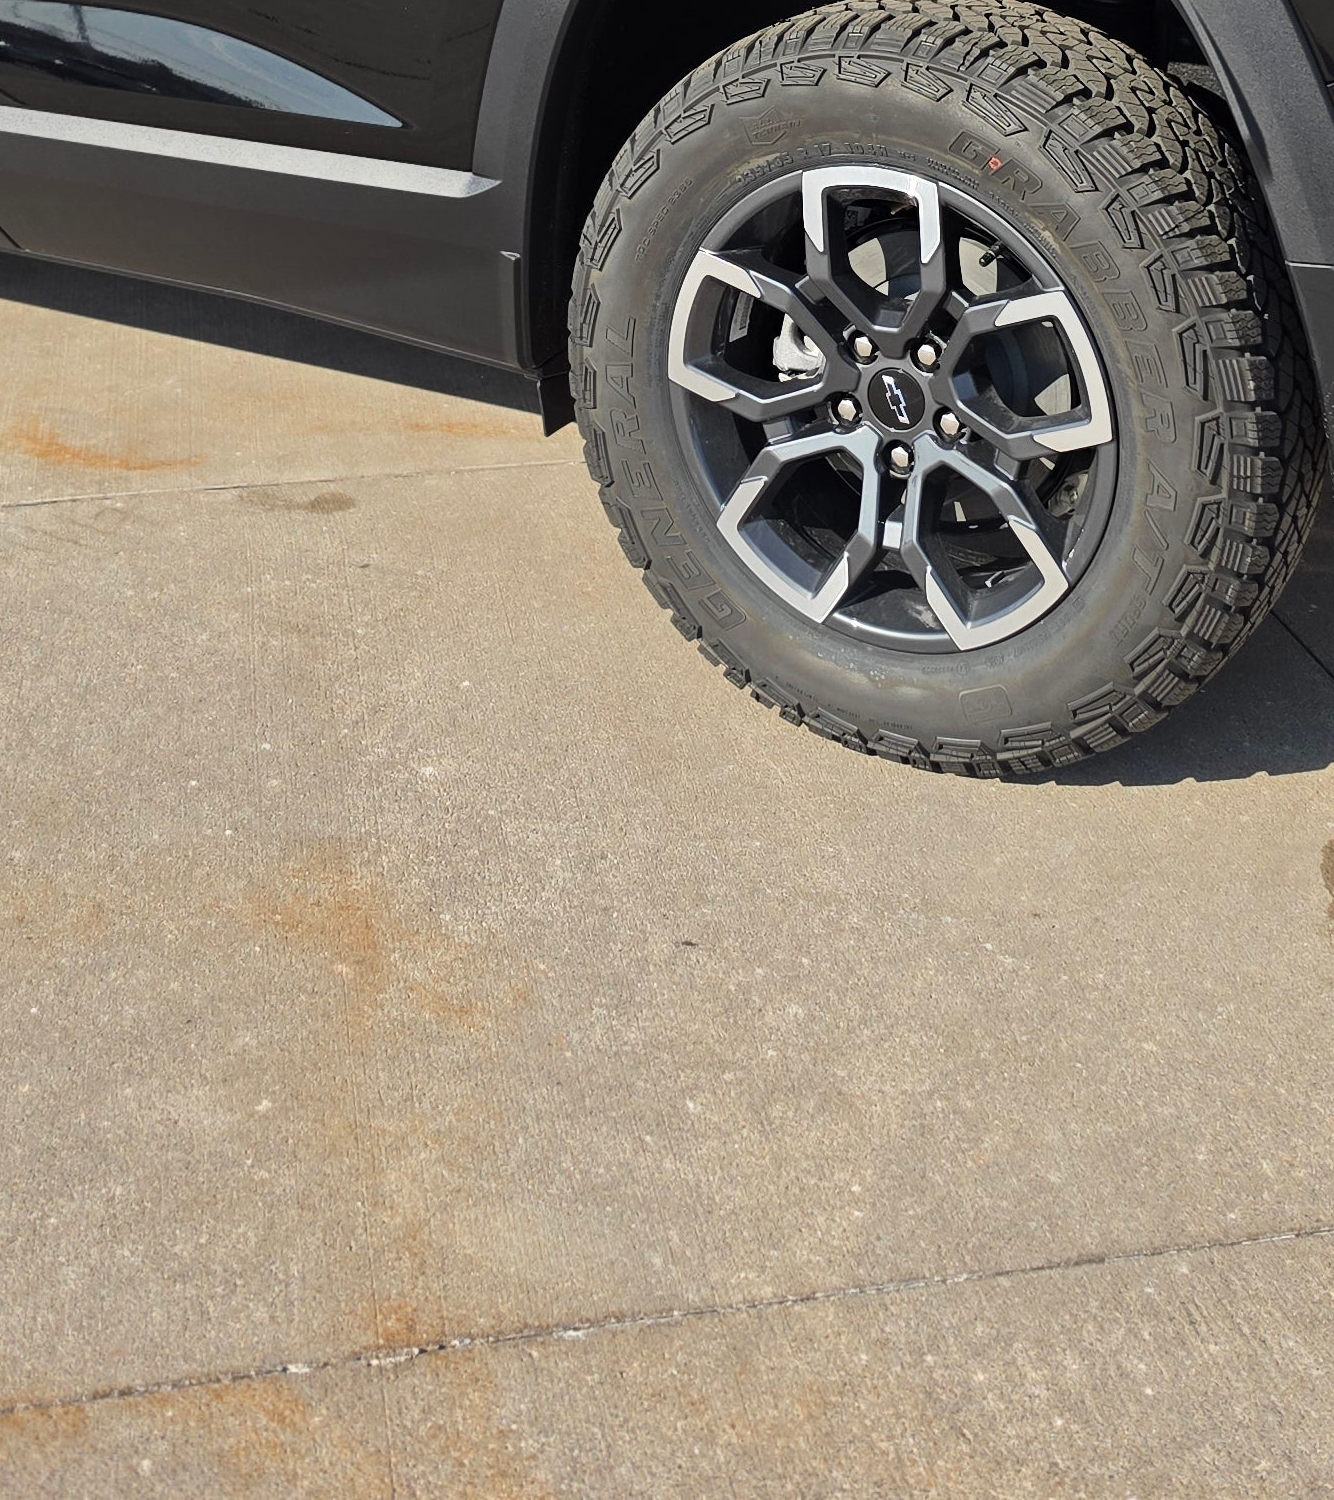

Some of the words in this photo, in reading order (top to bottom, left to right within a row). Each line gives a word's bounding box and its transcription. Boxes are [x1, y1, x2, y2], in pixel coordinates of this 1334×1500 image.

[605, 316, 747, 632] GENERAL
[948, 130, 1174, 438] GRABBER
[1128, 457, 1180, 598] A/T
